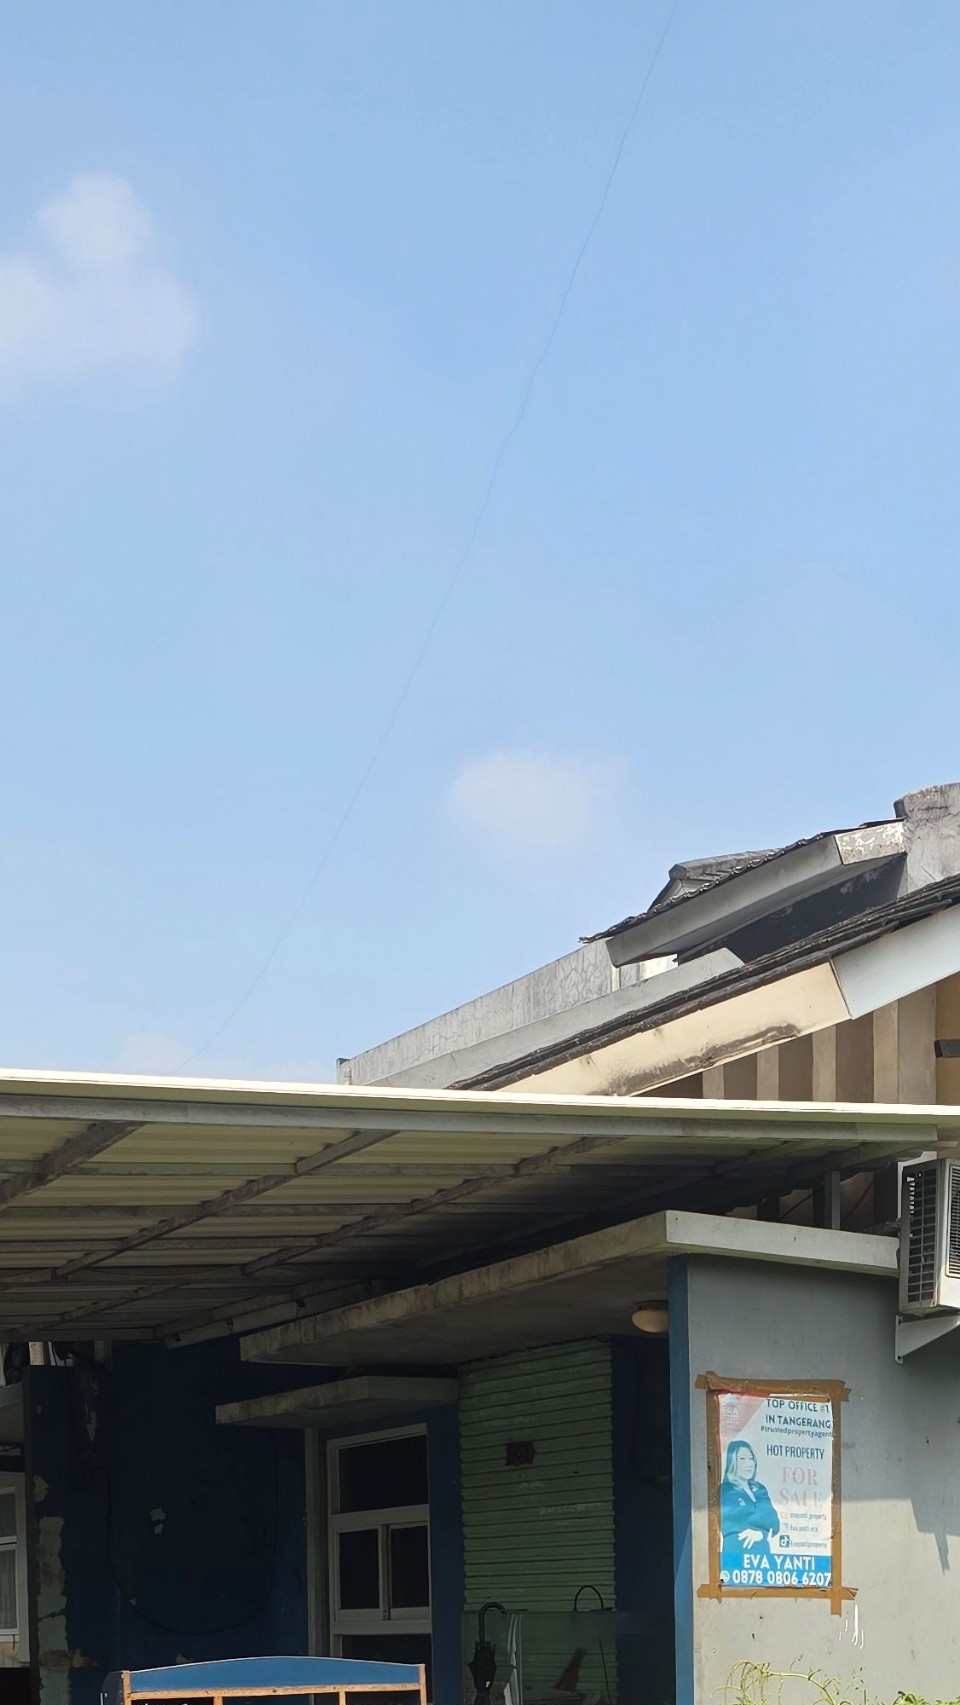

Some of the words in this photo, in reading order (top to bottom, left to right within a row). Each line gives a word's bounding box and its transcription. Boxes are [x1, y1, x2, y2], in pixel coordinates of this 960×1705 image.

[767, 1399, 785, 1409] TOP
[788, 1400, 818, 1412] OFFICE
[820, 1404, 830, 1413] #1
[765, 1414, 776, 1424] IN
[777, 1415, 832, 1429] TANGERANG
[766, 1444, 783, 1457] HOT
[785, 1445, 825, 1460] PROPERTY
[781, 1466, 818, 1486] FOR
[779, 1488, 823, 1508] SALE
[743, 1554, 770, 1569] EVA
[774, 1555, 815, 1571] YANTI
[732, 1570, 763, 1584] 0878
[767, 1571, 799, 1585] 0806
[802, 1572, 832, 1586] 6207
